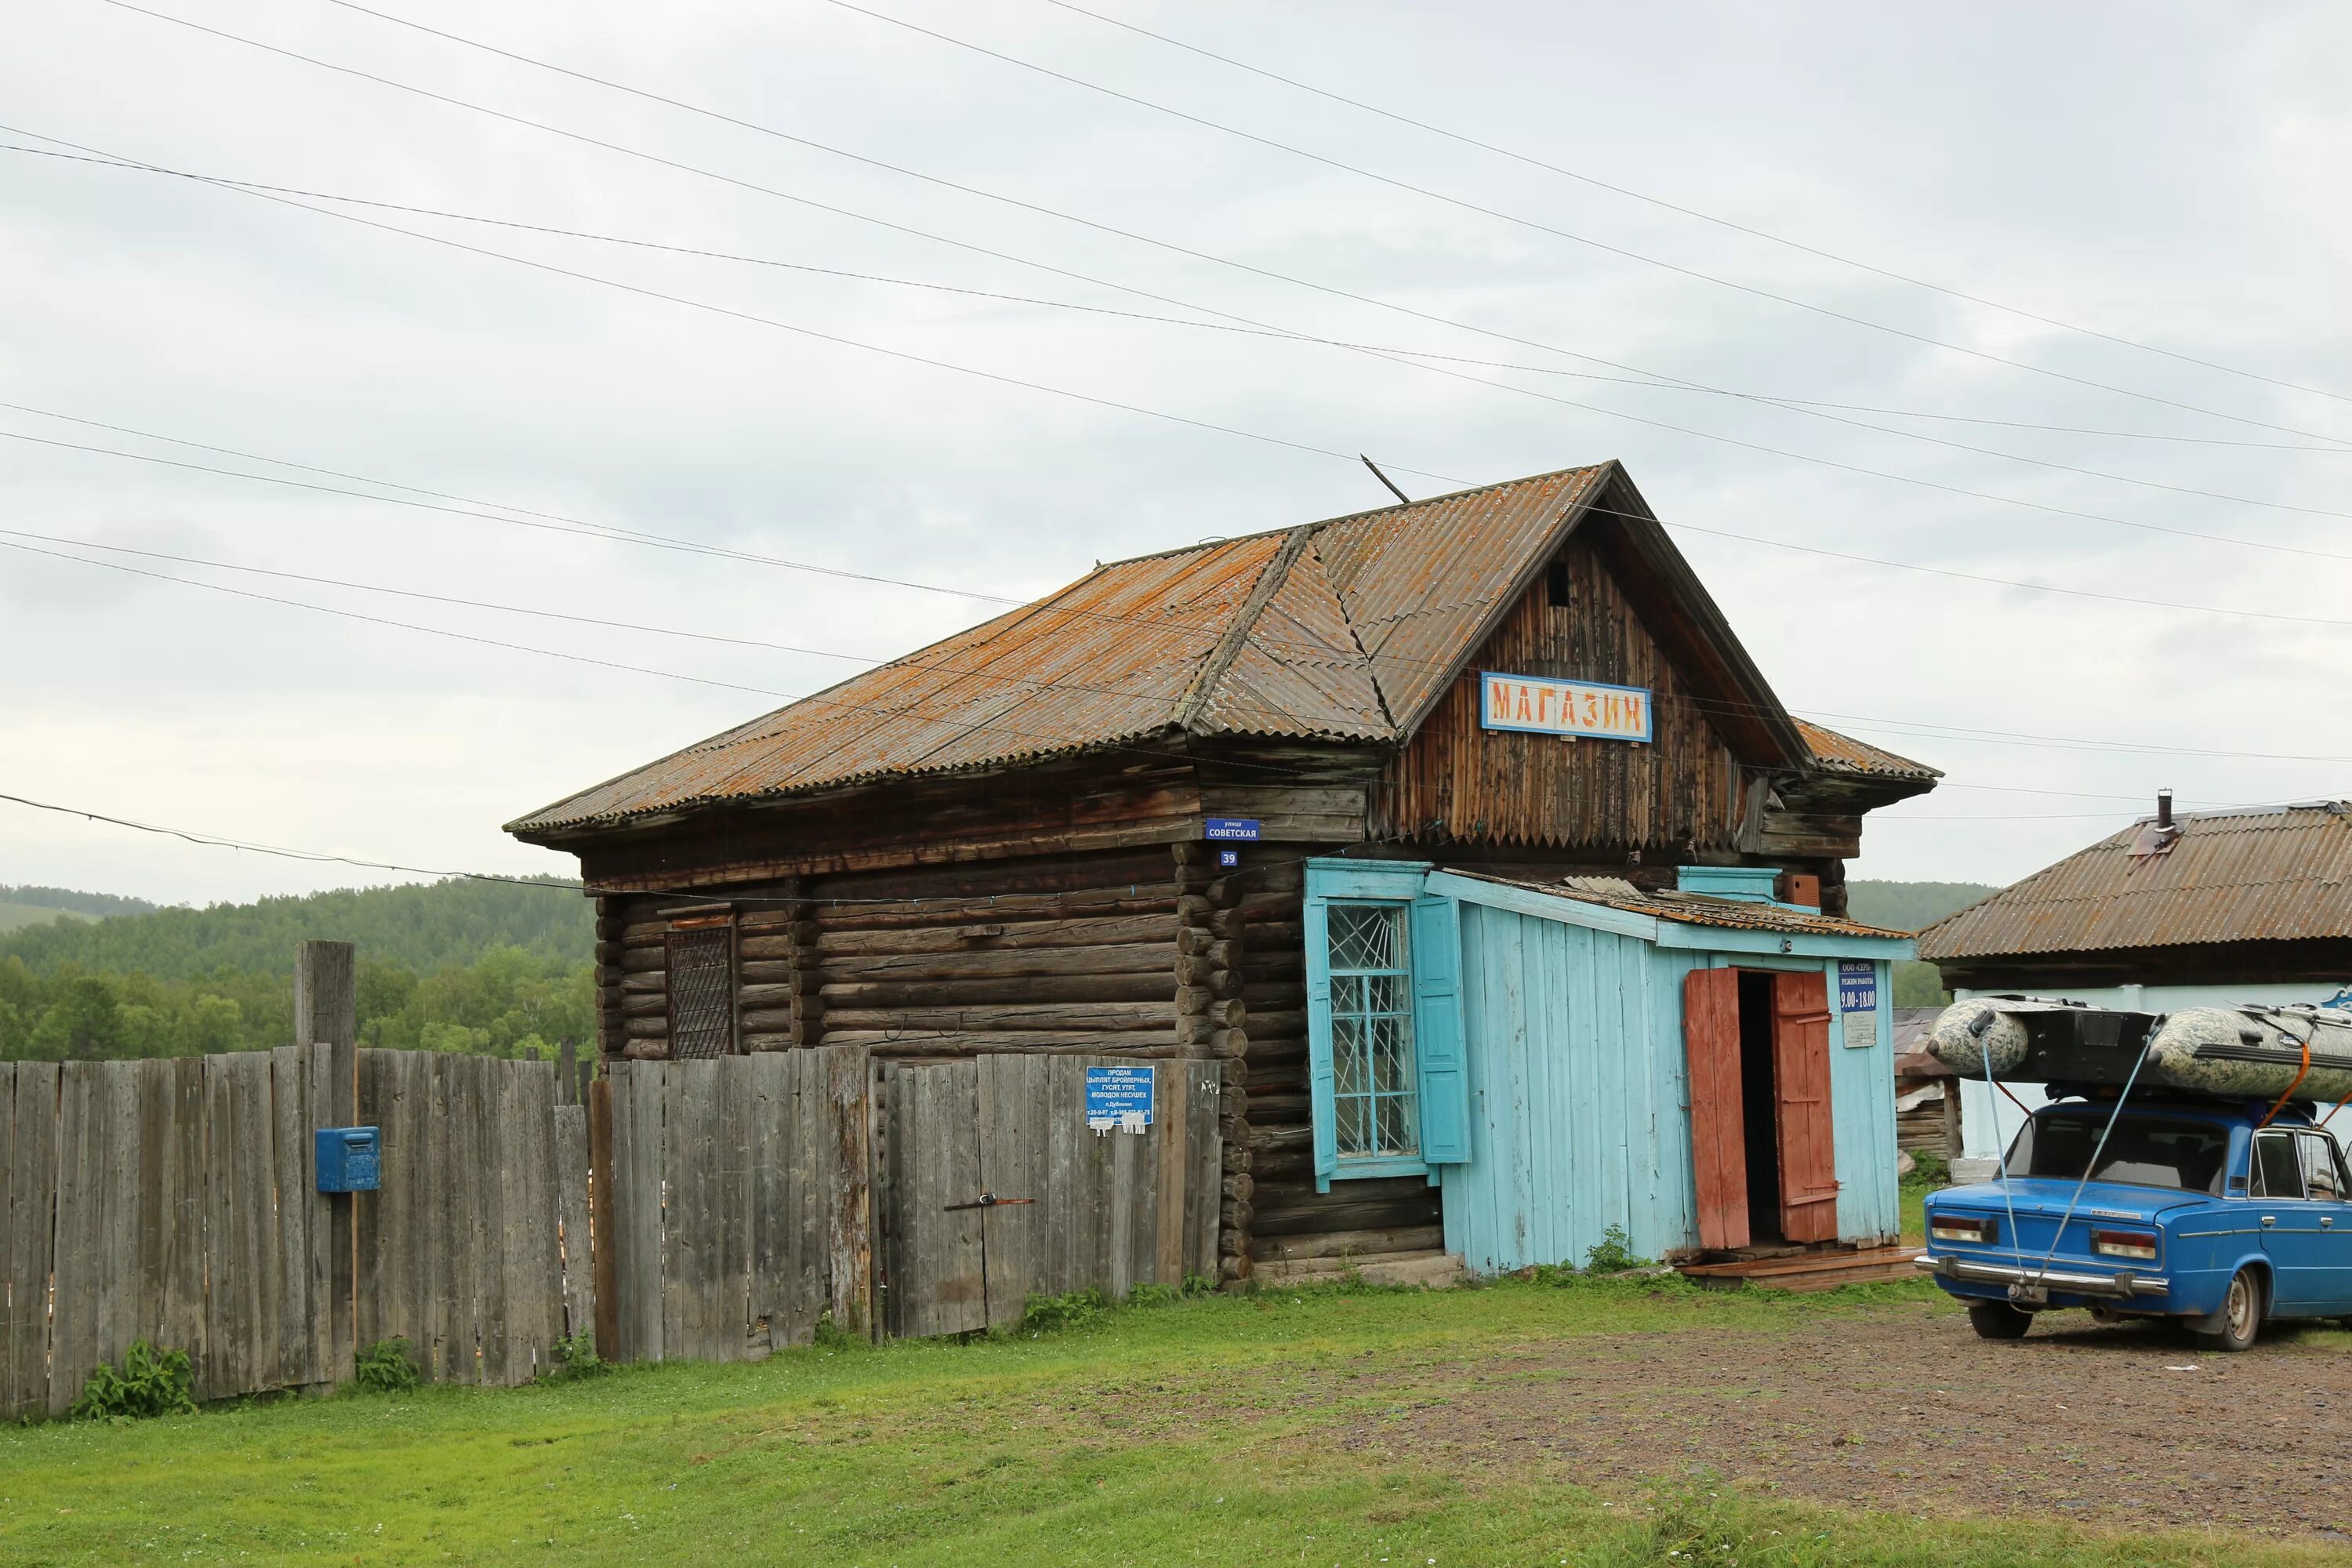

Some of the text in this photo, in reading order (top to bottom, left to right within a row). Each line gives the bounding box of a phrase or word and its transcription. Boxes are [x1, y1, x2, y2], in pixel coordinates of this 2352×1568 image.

[1493, 681, 1641, 731] МАГАЗИН
[1209, 829, 1257, 837] СОВЕТСКАЯ
[1223, 854, 1236, 863] 39
